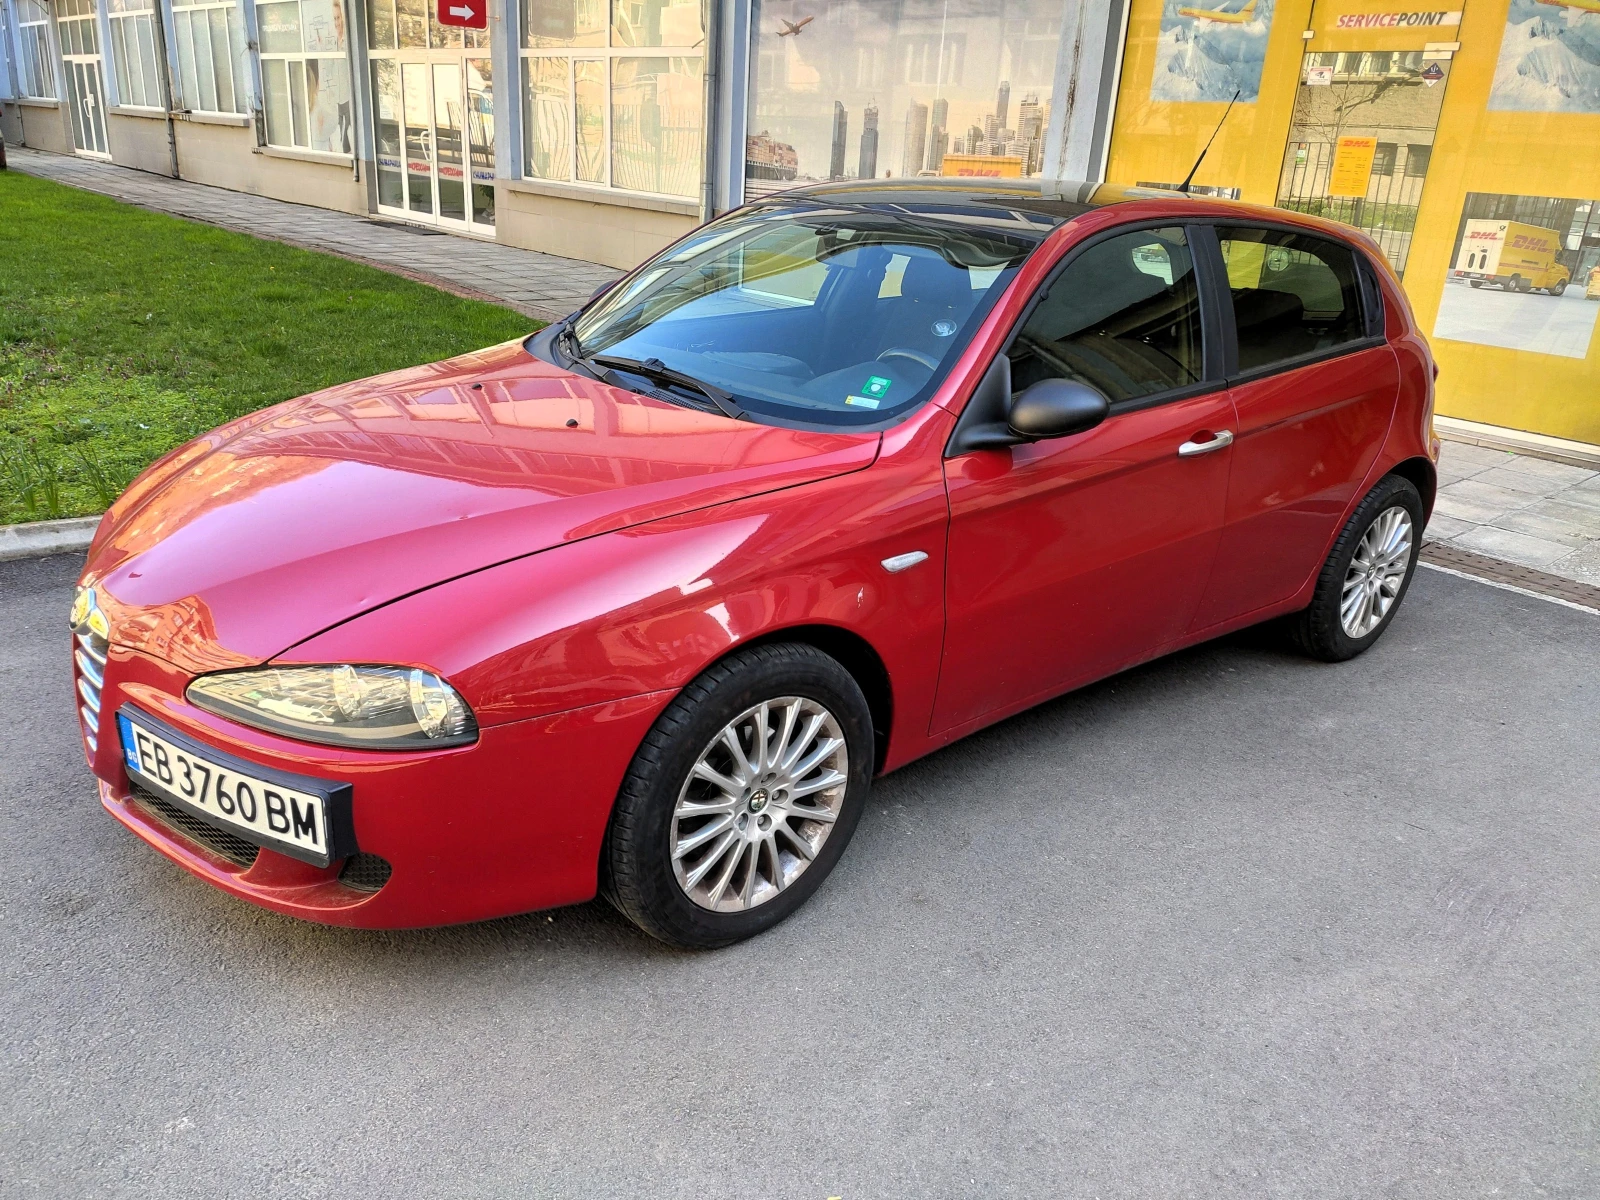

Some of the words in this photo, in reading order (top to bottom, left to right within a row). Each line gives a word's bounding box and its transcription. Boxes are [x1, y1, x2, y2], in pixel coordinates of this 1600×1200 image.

[1337, 12, 1447, 28] SERVICEPOINT
[1343, 140, 1371, 148] DHL
[1469, 231, 1498, 240] DHL
[1511, 234, 1549, 252] DHL
[126, 748, 138, 764] BG
[135, 731, 173, 786] EB
[177, 755, 257, 823] 3760
[263, 789, 318, 845] BM
